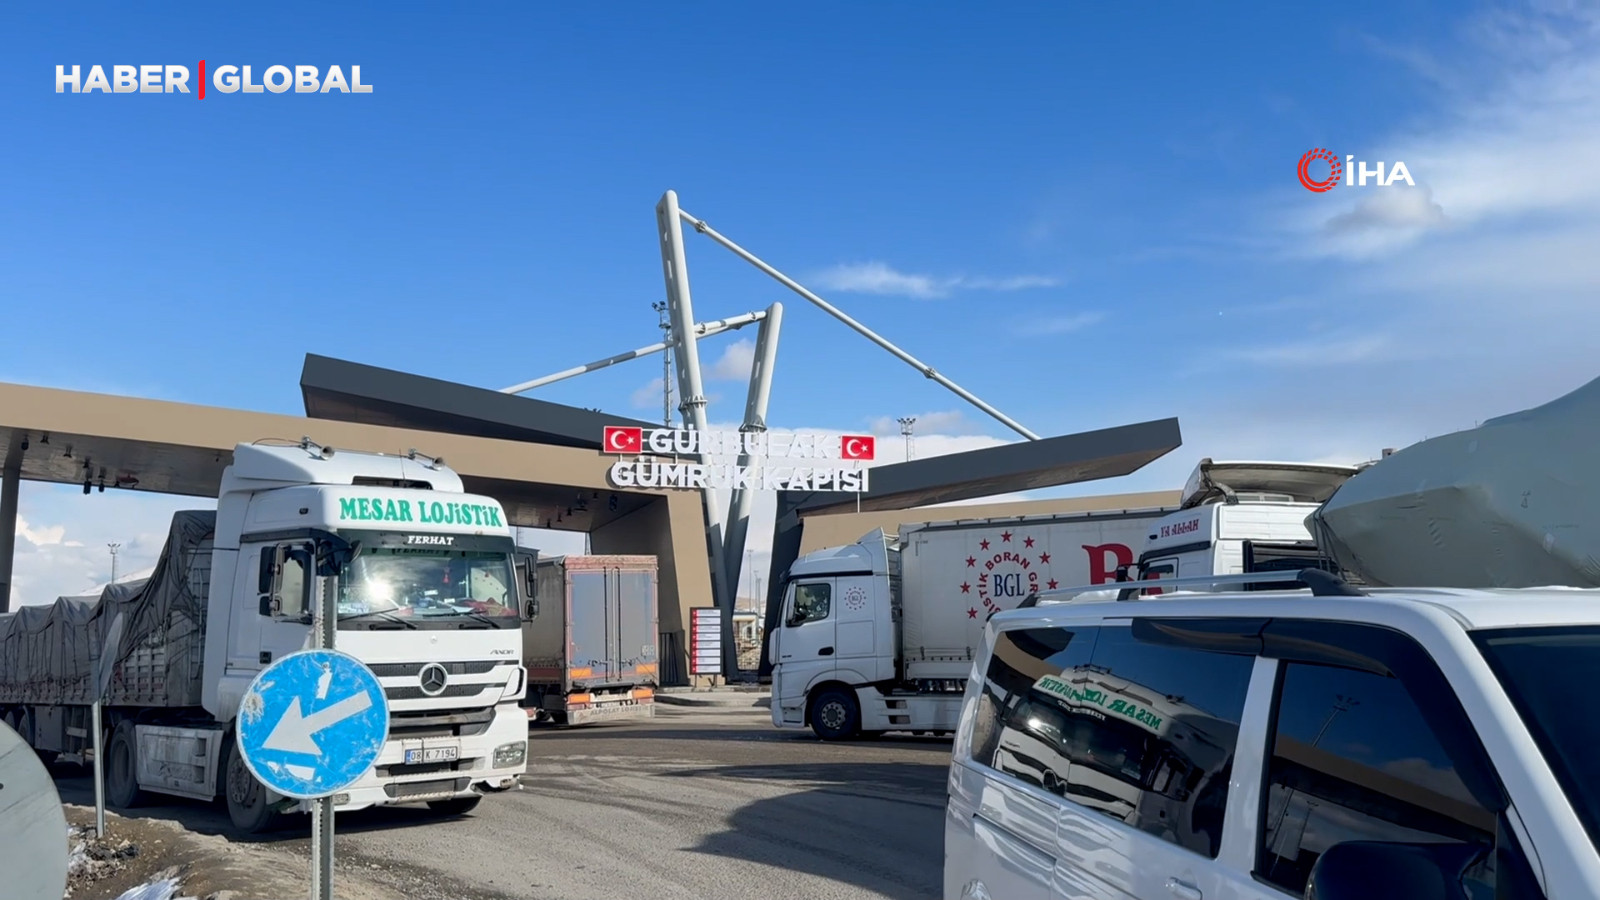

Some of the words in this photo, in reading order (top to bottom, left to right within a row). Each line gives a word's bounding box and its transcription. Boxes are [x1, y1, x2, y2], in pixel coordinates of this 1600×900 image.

[762, 465, 869, 492] KAPISI
[339, 497, 413, 522] MESAR
[407, 535, 454, 546] FERHAT
[985, 551, 1031, 571] BORAN
[1028, 572, 1039, 593] GR
[993, 573, 1025, 597] BGL
[410, 751, 422, 761] 08
